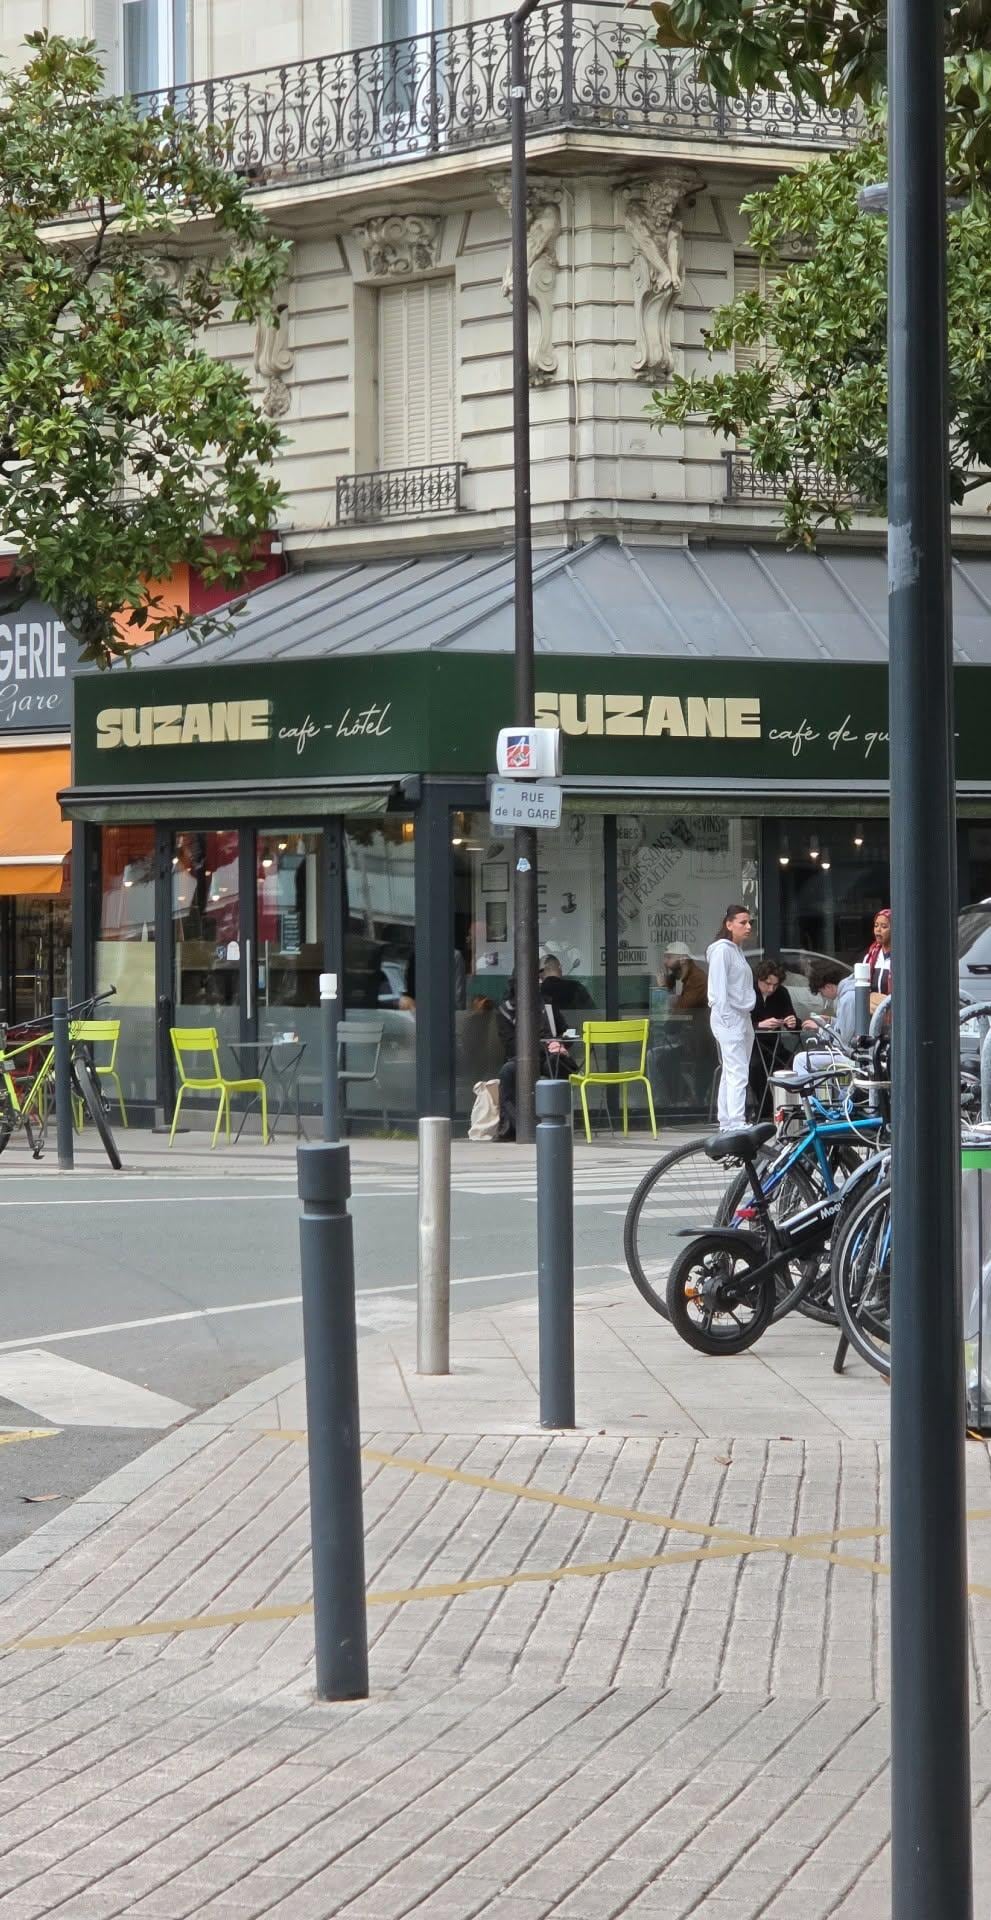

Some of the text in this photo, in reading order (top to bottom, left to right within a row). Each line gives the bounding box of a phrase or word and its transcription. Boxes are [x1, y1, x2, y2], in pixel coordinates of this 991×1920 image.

[96, 699, 271, 749] SUZANE
[534, 692, 761, 738] SUZANE
[768, 718, 820, 757] café
[827, 714, 858, 750] de
[521, 791, 545, 803] RUE
[495, 807, 557, 820] de la GARE
[622, 831, 673, 889] BOISSONS
[647, 913, 698, 928] BOISSONS
